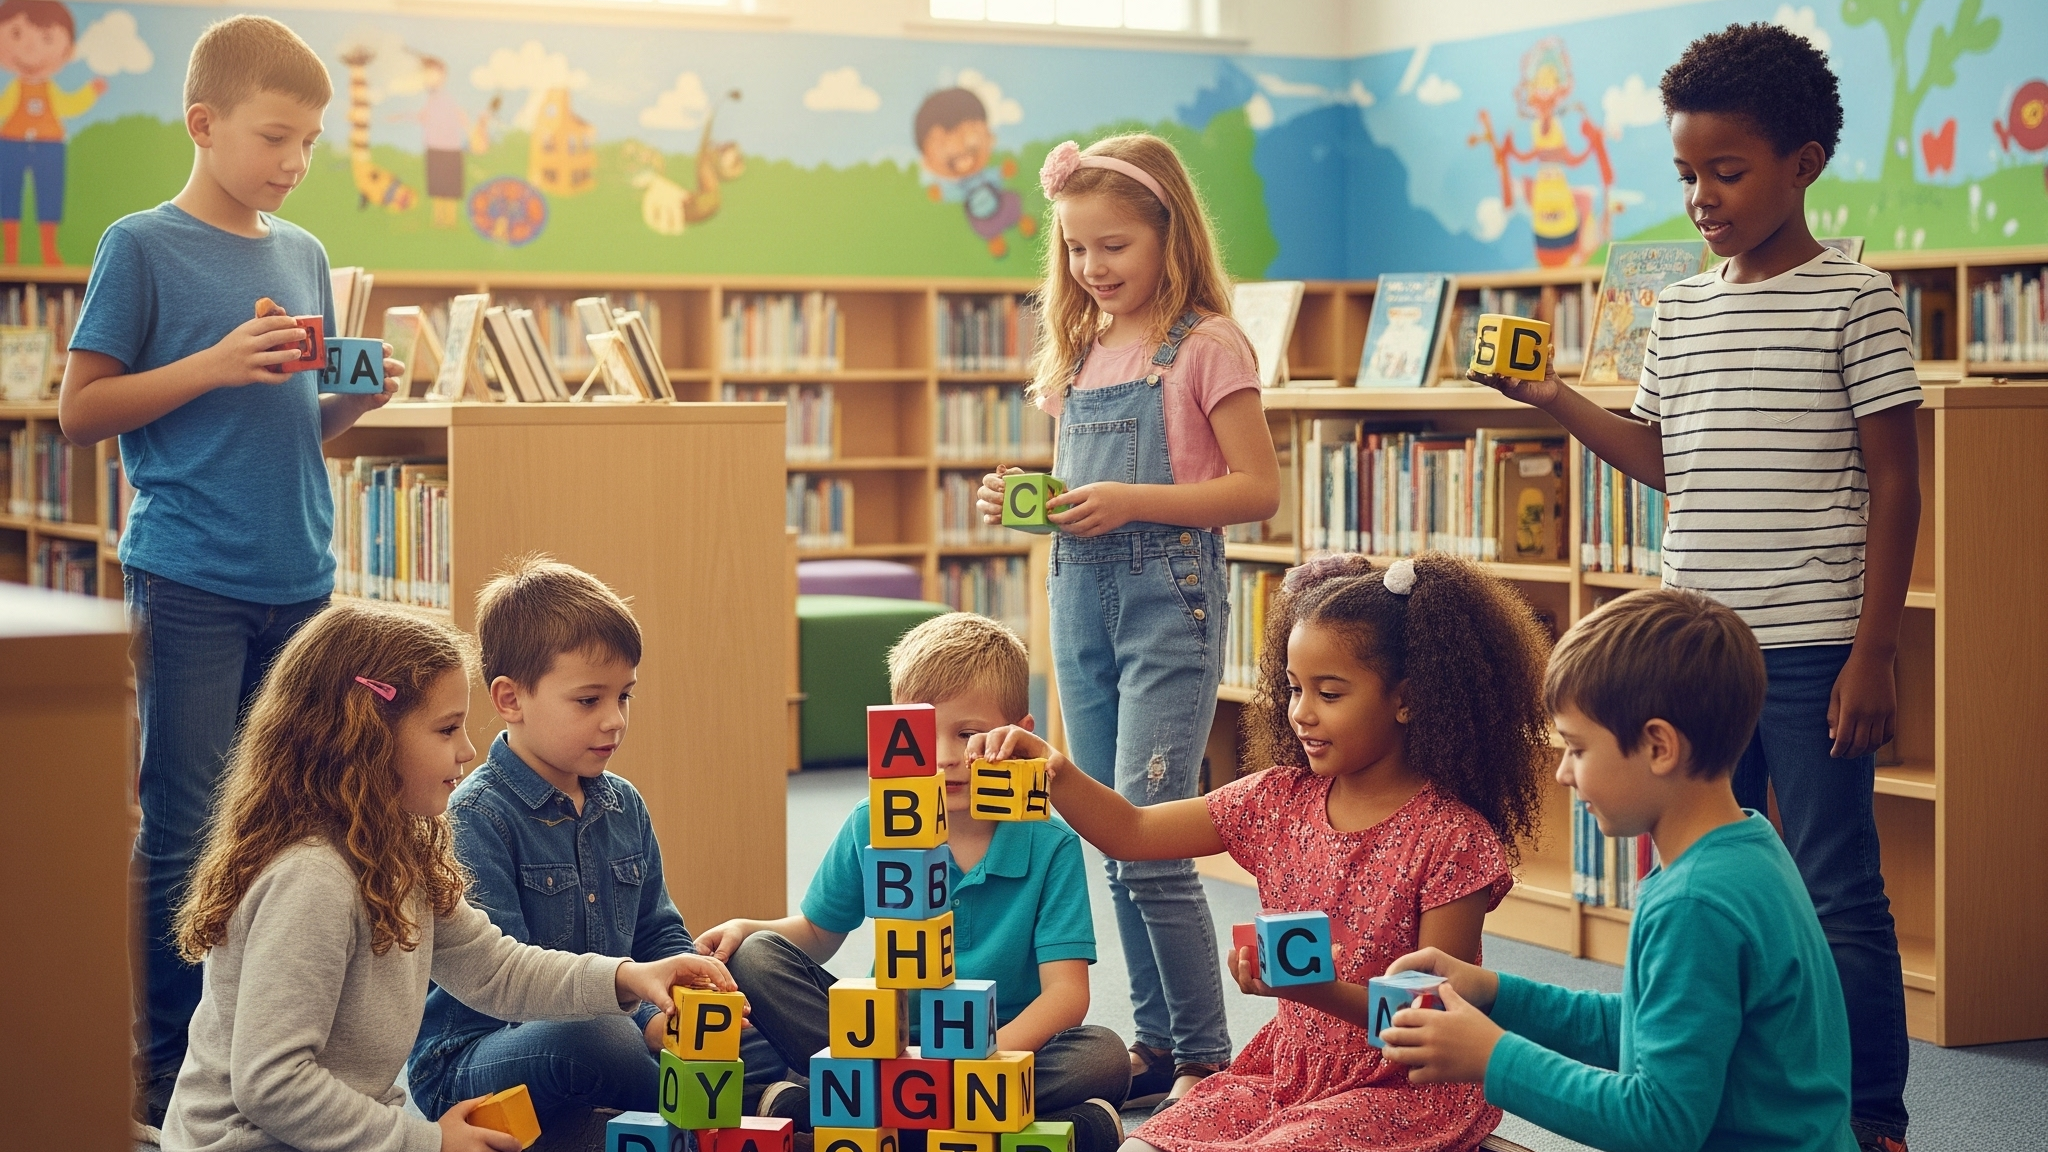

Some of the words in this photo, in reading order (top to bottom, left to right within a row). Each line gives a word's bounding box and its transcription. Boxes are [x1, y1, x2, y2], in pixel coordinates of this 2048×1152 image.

[349, 349, 379, 386] A
[1010, 482, 1038, 518] C
[881, 718, 926, 768] A
[883, 789, 923, 837] B
[935, 785, 947, 835] A
[877, 861, 914, 909] B
[928, 861, 947, 909] B
[887, 930, 927, 979] H
[694, 1003, 732, 1051] P
[846, 999, 875, 1048] J
[934, 1000, 974, 1049] H
[695, 1070, 733, 1119] Y
[822, 1069, 861, 1118] N
[892, 1069, 937, 1120] G
[966, 1072, 1007, 1122] N
[1021, 1066, 1032, 1117] N
